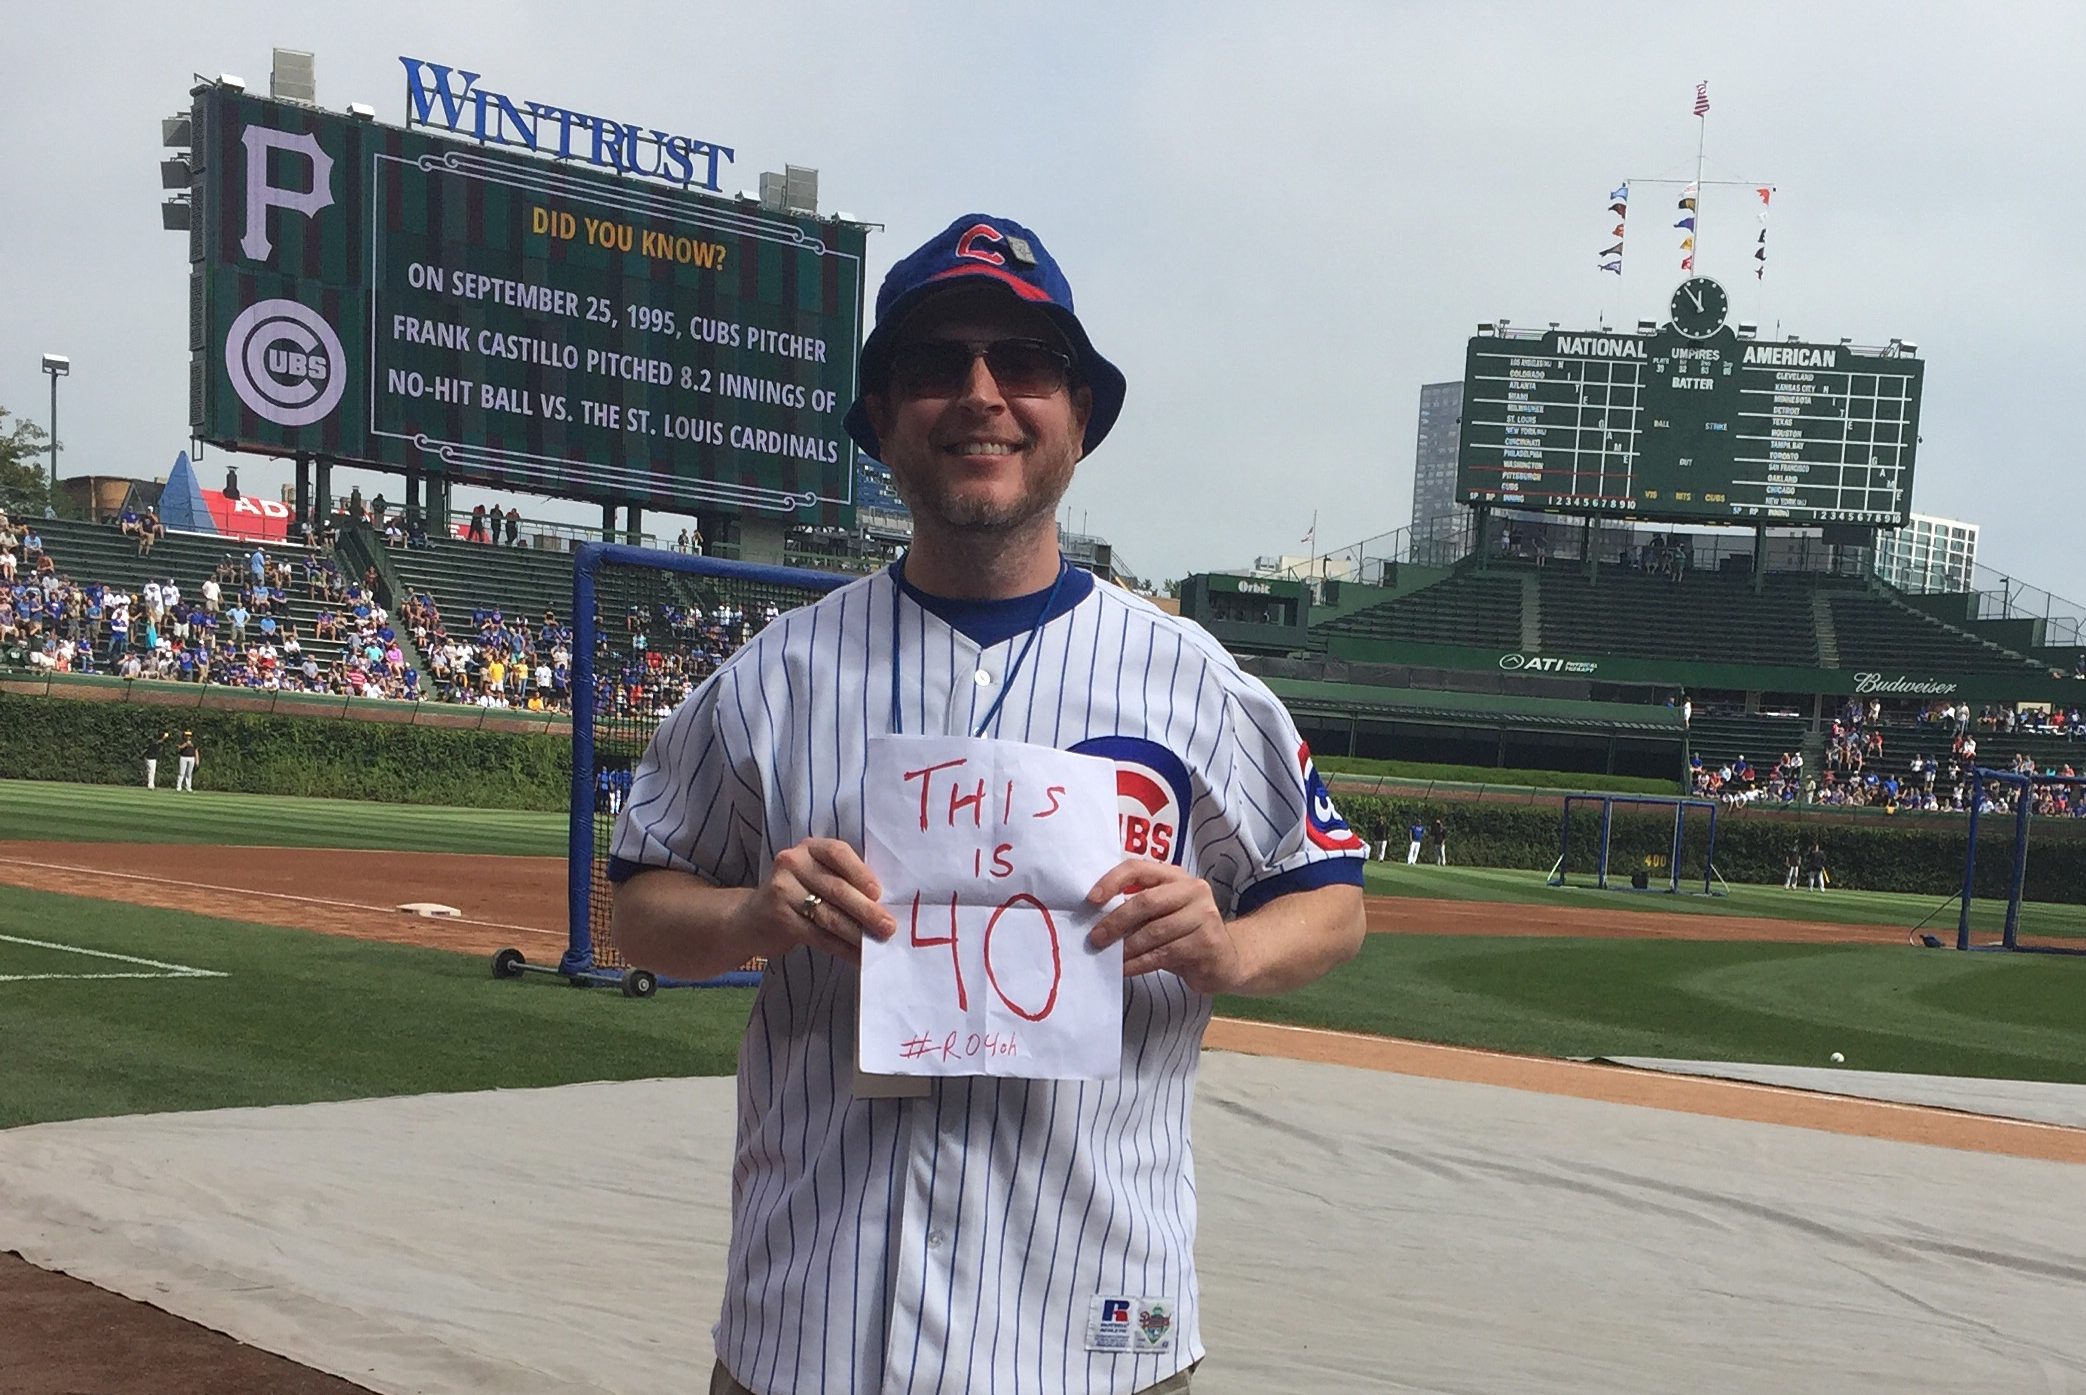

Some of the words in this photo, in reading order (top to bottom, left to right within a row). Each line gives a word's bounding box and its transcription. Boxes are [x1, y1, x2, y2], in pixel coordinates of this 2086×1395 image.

[399, 57, 735, 192] WINTRUST
[240, 124, 335, 261] P
[533, 206, 577, 241] DID
[584, 217, 634, 252] YOU
[642, 230, 727, 271] KNOW?
[956, 223, 1005, 265] C
[408, 262, 445, 292] ON
[452, 270, 581, 318] SEPTEMBER
[586, 296, 627, 328] 25,
[626, 304, 682, 341] 1995,
[690, 316, 740, 348] CUBS
[746, 327, 827, 371] PITCHER
[1557, 336, 1648, 359] NATIONAL
[1671, 347, 1721, 361] UMPIRES
[1742, 346, 1836, 368] AMERICAN
[393, 315, 471, 353] FRANK
[477, 329, 580, 370] CASTILLO
[586, 354, 673, 392] PITCHED
[680, 365, 711, 394] 8.2
[719, 378, 806, 410] INNINGS
[811, 388, 838, 414] OF
[1510, 369, 1545, 379] COLORADO
[1776, 372, 1815, 382] CLEVELAND
[1509, 381, 1537, 390] ATLANTA
[1672, 376, 1714, 390] BATTER
[1775, 383, 1801, 392] KANSAS
[1801, 384, 1816, 393] CITY
[388, 369, 474, 406] NO-HIT
[480, 384, 534, 416] BALL
[539, 392, 574, 424] VS.
[580, 400, 620, 429] THE
[626, 406, 657, 437] ST.
[663, 416, 724, 448] LOUIS
[729, 426, 839, 465] CARDINALS
[1773, 406, 1801, 416] DETROIT
[1772, 417, 1793, 427] TEXAS
[1771, 428, 1803, 438] HOUSTON
[1769, 451, 1799, 461] TORONTO
[1503, 460, 1545, 470] WASHINGTON
[1768, 463, 1780, 471] SAN
[1767, 474, 1799, 484] OAKLAND
[1766, 485, 1796, 495] CHICAGO
[1548, 496, 1552, 505] 1
[1556, 496, 1562, 506] 2
[1565, 497, 1571, 507] 3
[1574, 497, 1580, 507] 4
[1583, 497, 1589, 507] 5
[1592, 498, 1598, 508] 6
[1601, 499, 1607, 508] 7
[1610, 499, 1616, 509] 8
[1619, 500, 1625, 509] 9
[1627, 500, 1636, 510] 10
[1765, 497, 1779, 505] NEW
[1813, 510, 1817, 519] 1
[1820, 511, 1827, 520] 2
[1830, 511, 1836, 521] 3
[1839, 512, 1845, 521] 4
[1848, 512, 1854, 522] 5
[1857, 513, 1864, 522] 6
[1867, 513, 1873, 522] 7
[1875, 513, 1882, 523] 8
[1885, 514, 1891, 523] 9
[1892, 514, 1901, 524] 10
[1523, 657, 1564, 672] ATI
[1853, 672, 1957, 694] Budweiser
[904, 758, 1066, 832] THIS
[974, 842, 1014, 878] IS
[1644, 854, 1667, 868] 400
[911, 889, 1061, 1022] 40
